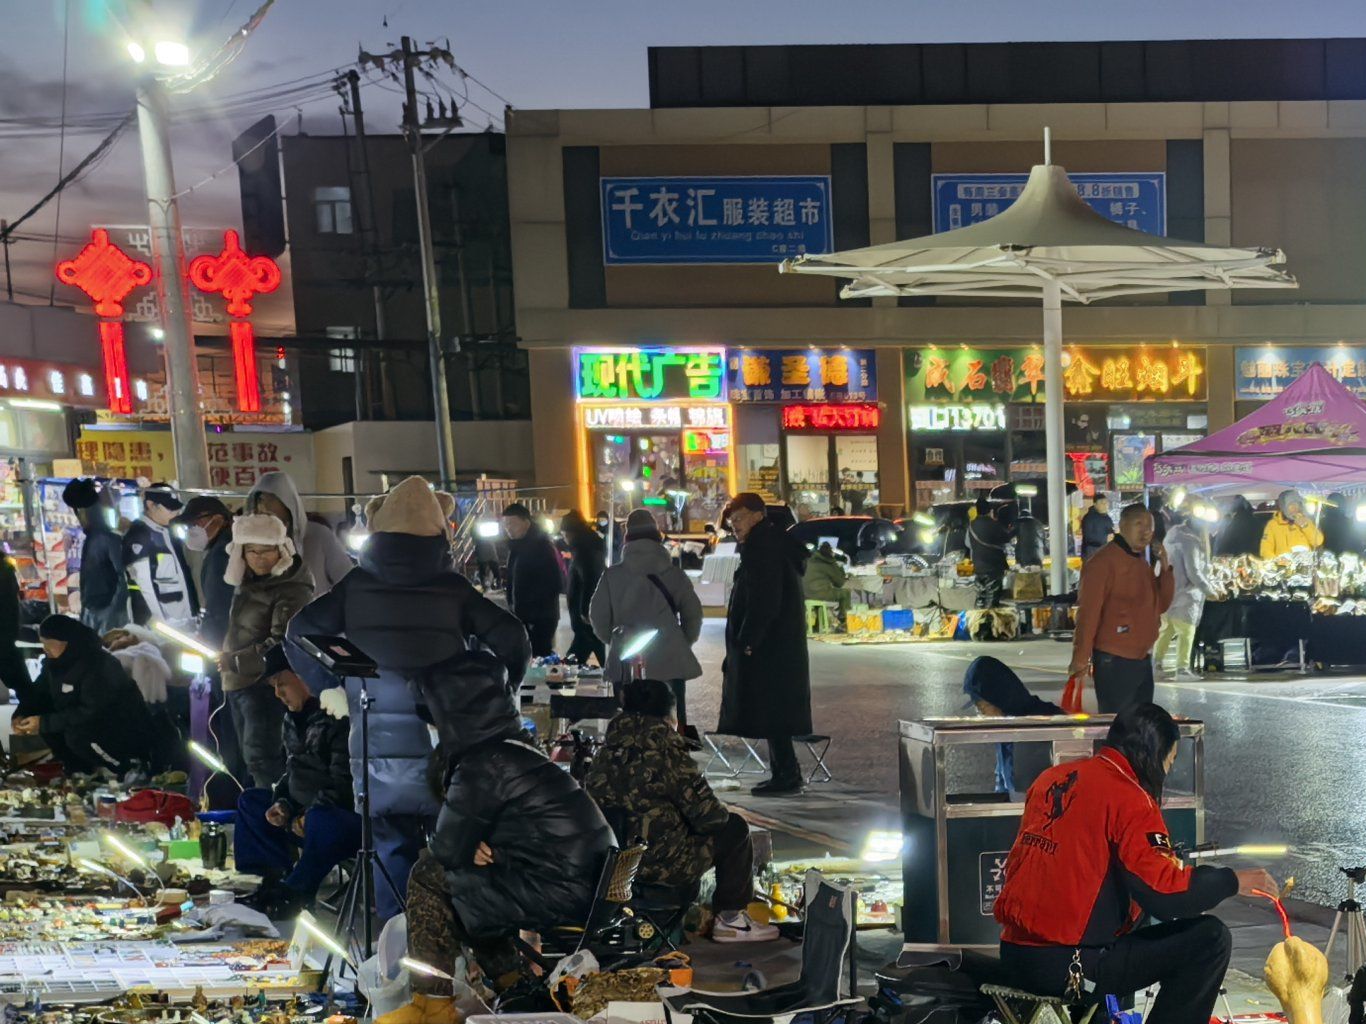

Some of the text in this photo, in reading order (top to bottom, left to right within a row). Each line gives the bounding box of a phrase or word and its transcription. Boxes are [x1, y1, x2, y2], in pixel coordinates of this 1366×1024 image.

[612, 186, 821, 229] 千衣汇服装超市
[580, 352, 723, 399] 现代广告
